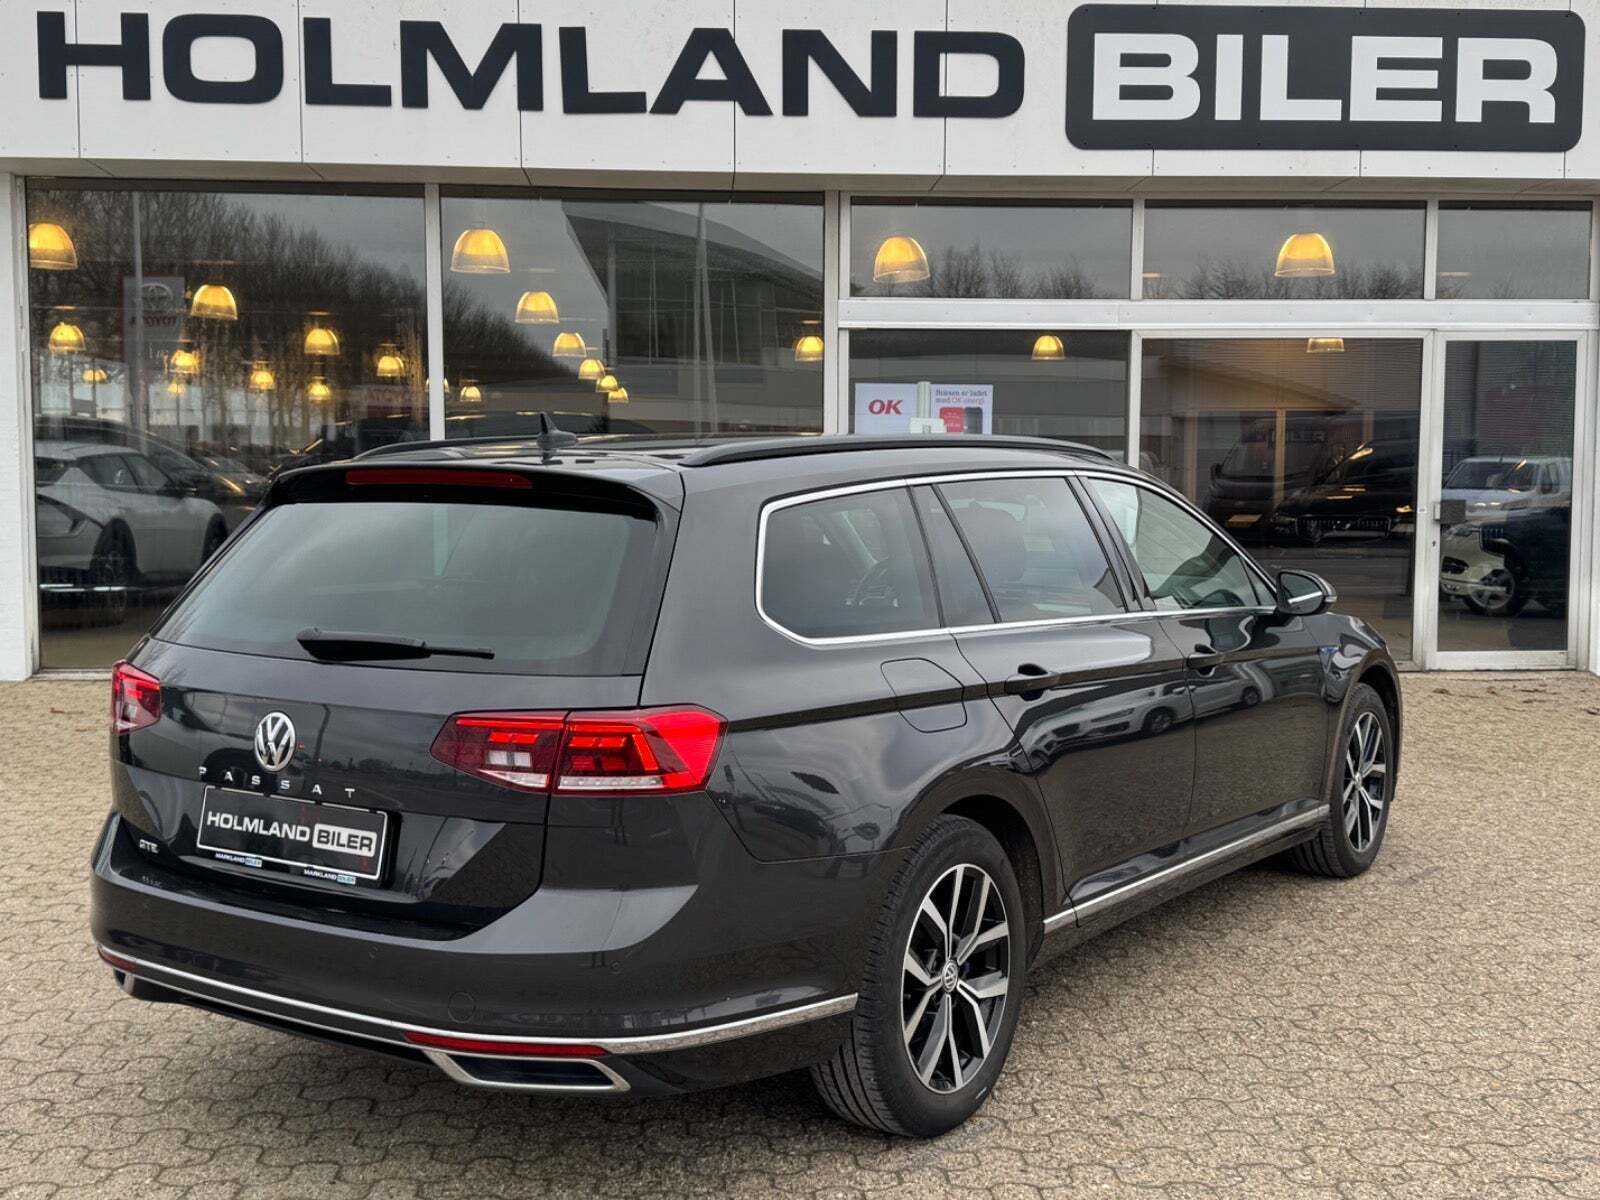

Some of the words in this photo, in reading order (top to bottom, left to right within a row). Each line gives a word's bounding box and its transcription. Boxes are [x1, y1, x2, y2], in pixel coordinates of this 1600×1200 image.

[37, 11, 1025, 118] HOLMLAND
[1092, 32, 1558, 123] BILER
[868, 399, 903, 415] OK
[198, 766, 356, 798] PASSAT
[207, 811, 310, 842] HOLMLAND
[316, 829, 374, 852] BILER
[215, 852, 245, 864] MARKLAND
[303, 868, 337, 880] MARKLAND
